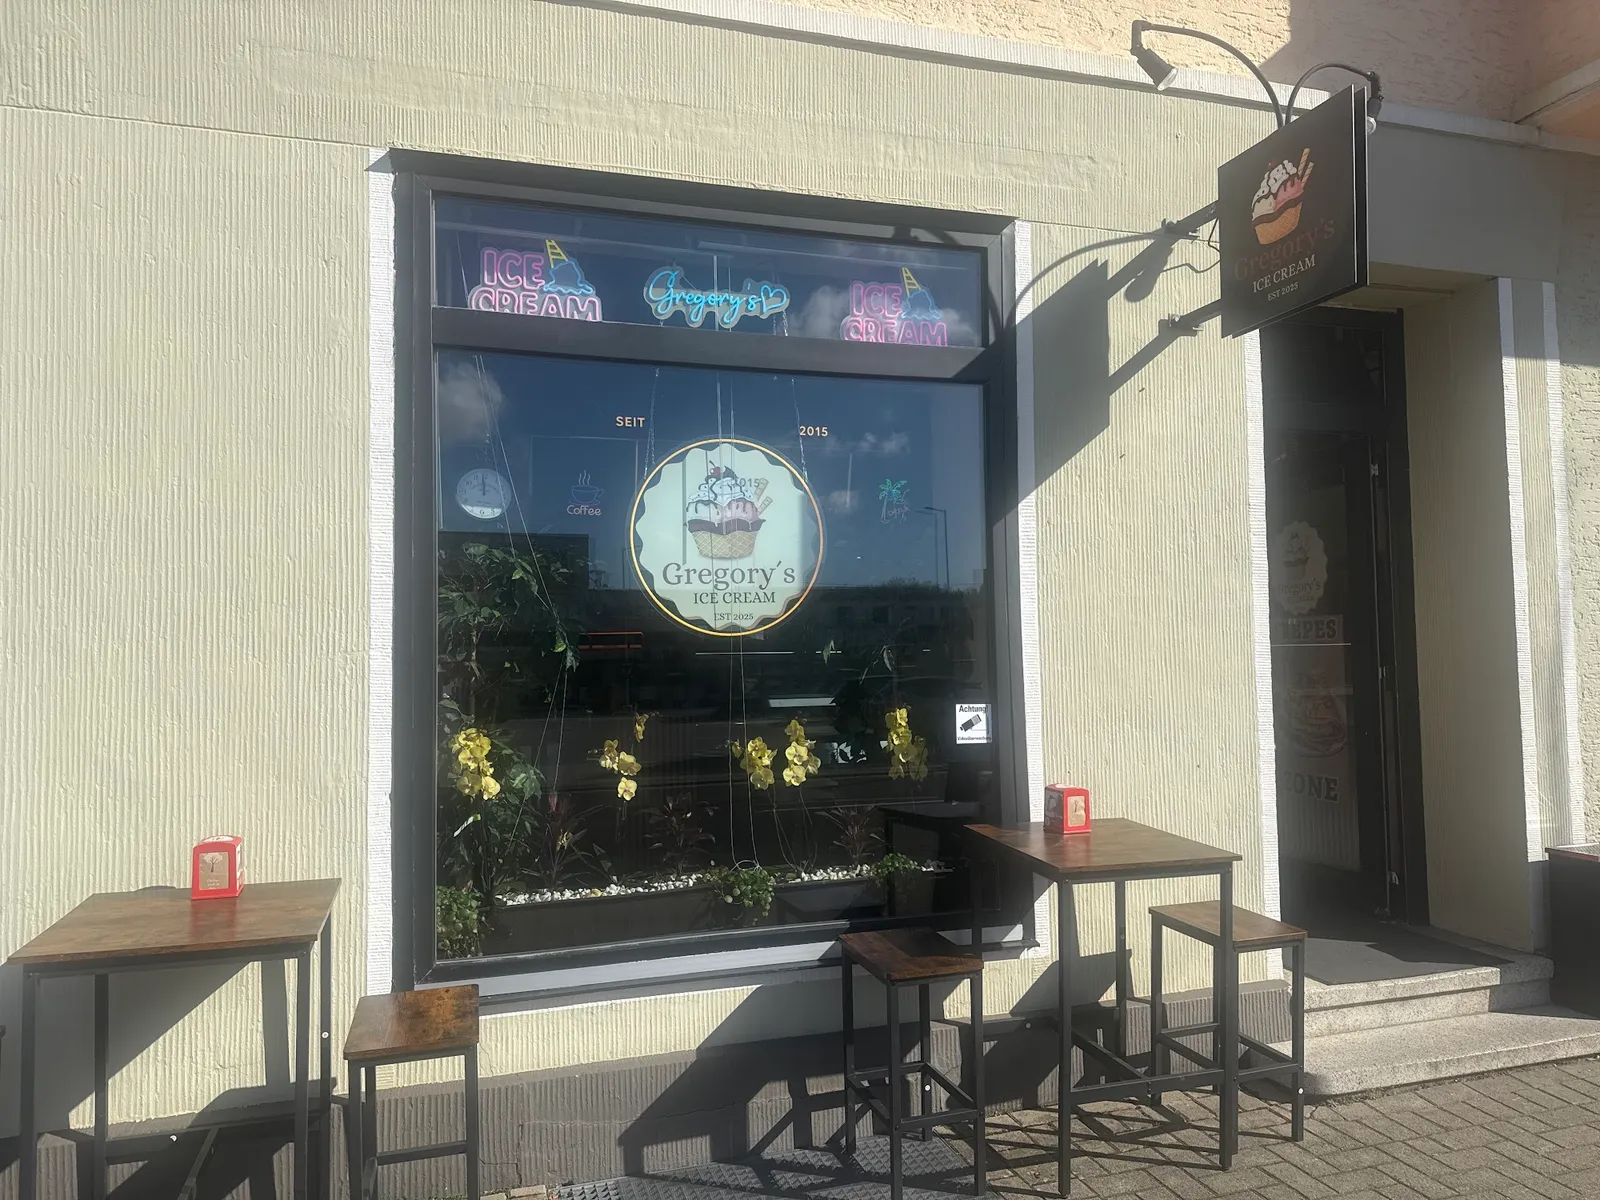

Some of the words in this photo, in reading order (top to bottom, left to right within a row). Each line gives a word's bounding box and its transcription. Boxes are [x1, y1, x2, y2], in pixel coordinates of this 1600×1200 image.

[484, 249, 546, 290] ICE
[1252, 275, 1272, 294] ICE
[1273, 254, 1316, 284] CREAM
[471, 287, 600, 322] CREAM
[649, 270, 758, 323] Gregory's
[853, 283, 903, 318] ICE
[1267, 288, 1281, 301] EST
[1282, 281, 1299, 295] 2025
[843, 317, 948, 347] CREAM
[616, 416, 646, 428] SEIT
[799, 425, 829, 437] 2015
[566, 504, 602, 516] Coffee
[662, 560, 796, 591] Gregory's
[693, 592, 719, 604] ICE
[722, 591, 776, 604] CREAM
[713, 613, 732, 621] EST
[733, 613, 754, 621] 2025
